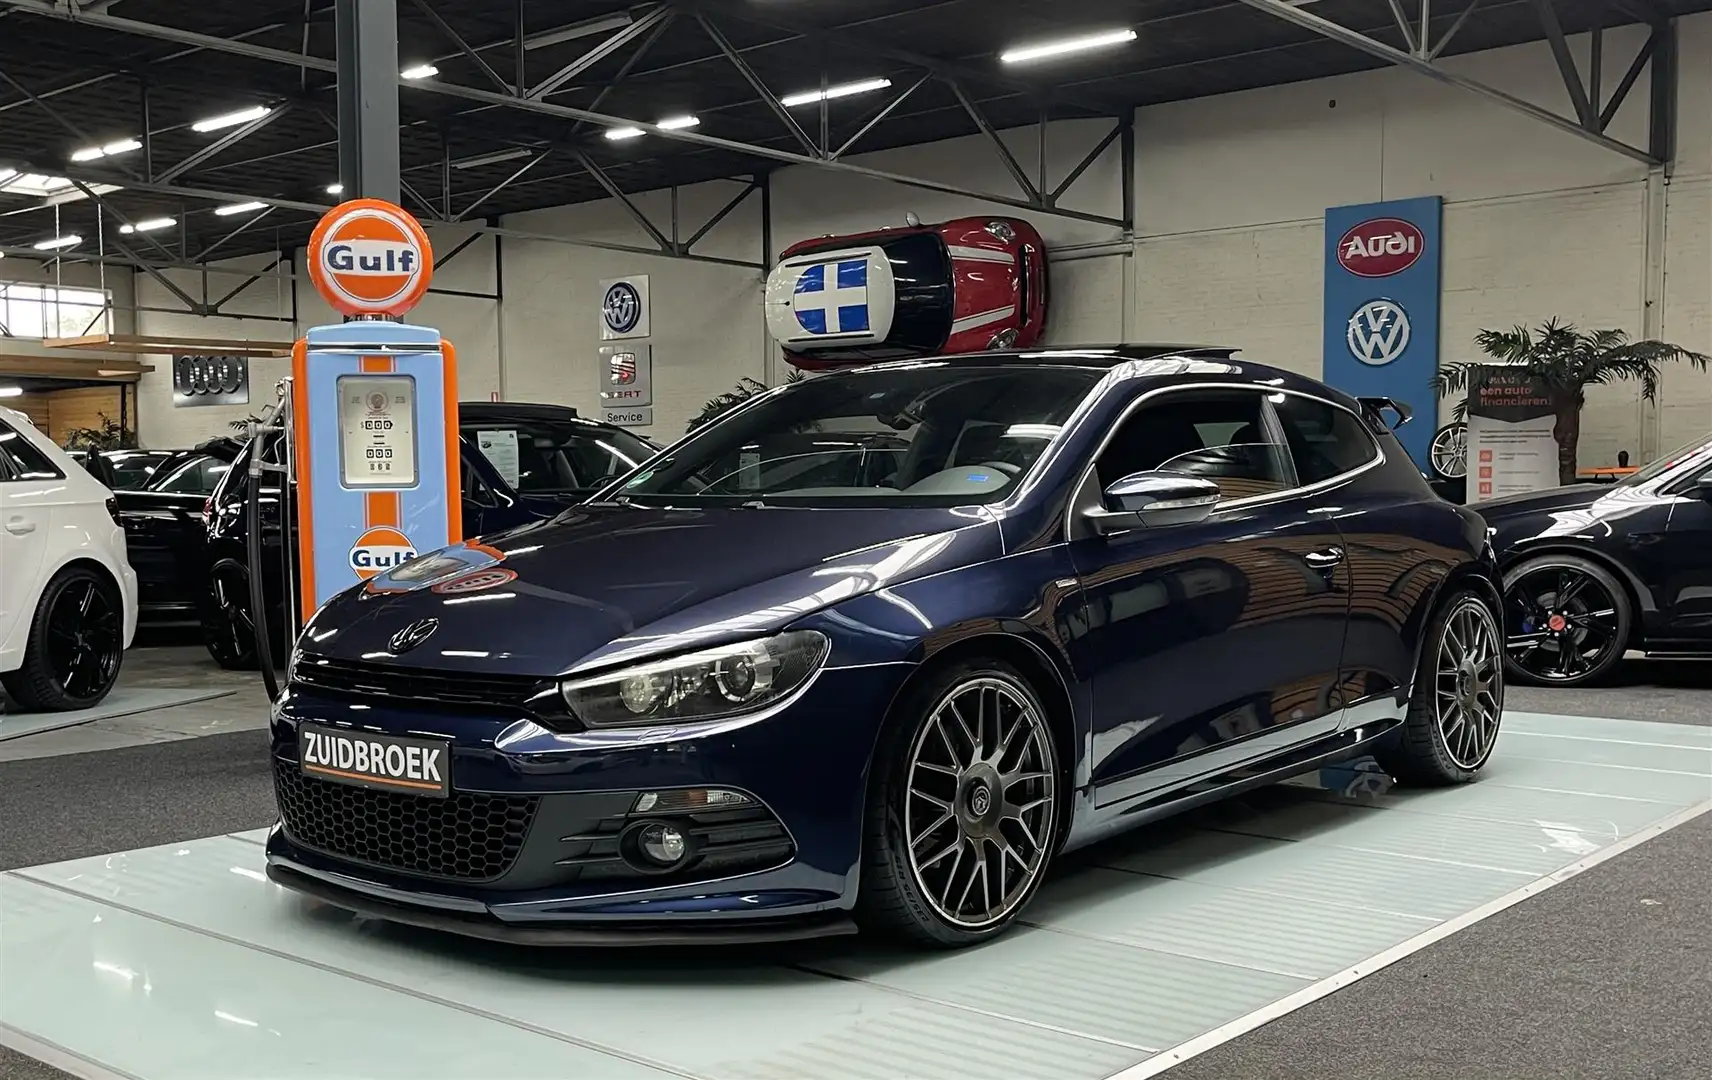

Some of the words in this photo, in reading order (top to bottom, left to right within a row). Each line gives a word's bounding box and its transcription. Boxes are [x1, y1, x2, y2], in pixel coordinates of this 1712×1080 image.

[327, 244, 414, 272] Gulf
[607, 412, 643, 423] Service
[304, 731, 442, 782] ZUIDBROEK
